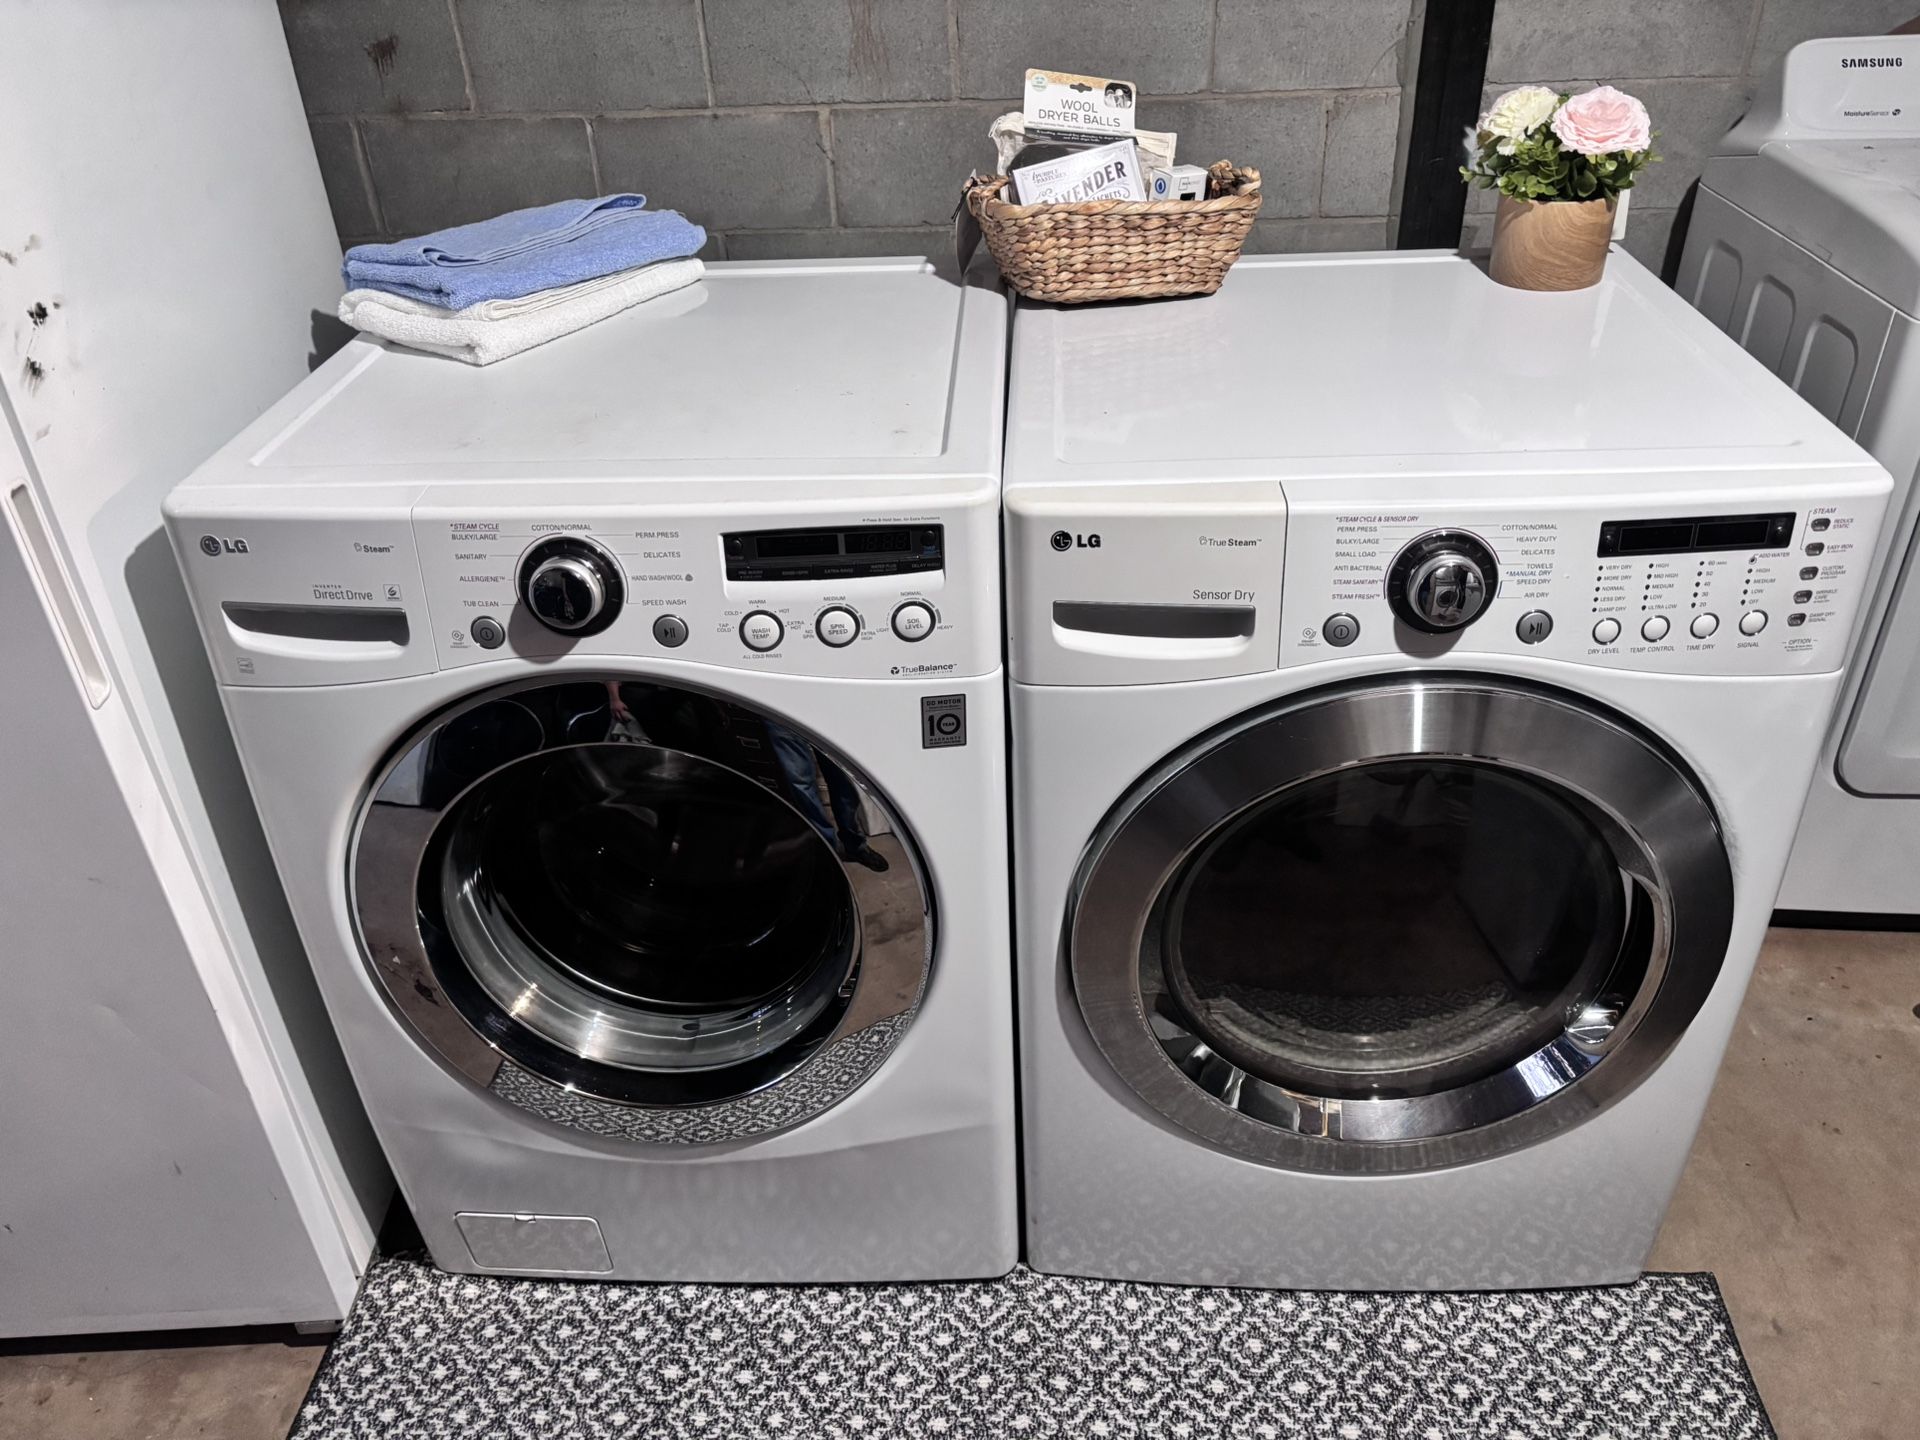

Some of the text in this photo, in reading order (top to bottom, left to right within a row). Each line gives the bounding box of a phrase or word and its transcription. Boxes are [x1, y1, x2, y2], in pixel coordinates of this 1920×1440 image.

[1841, 57, 1903, 68] SAMSUNG
[1061, 99, 1098, 114] WOOL
[1038, 109, 1121, 127] DRYER BALLS
[1045, 161, 1126, 203] VENDER
[223, 540, 248, 553] LG
[1077, 534, 1101, 548] LG
[1193, 590, 1255, 603] Sensor Dry
[928, 713, 961, 736] 10
